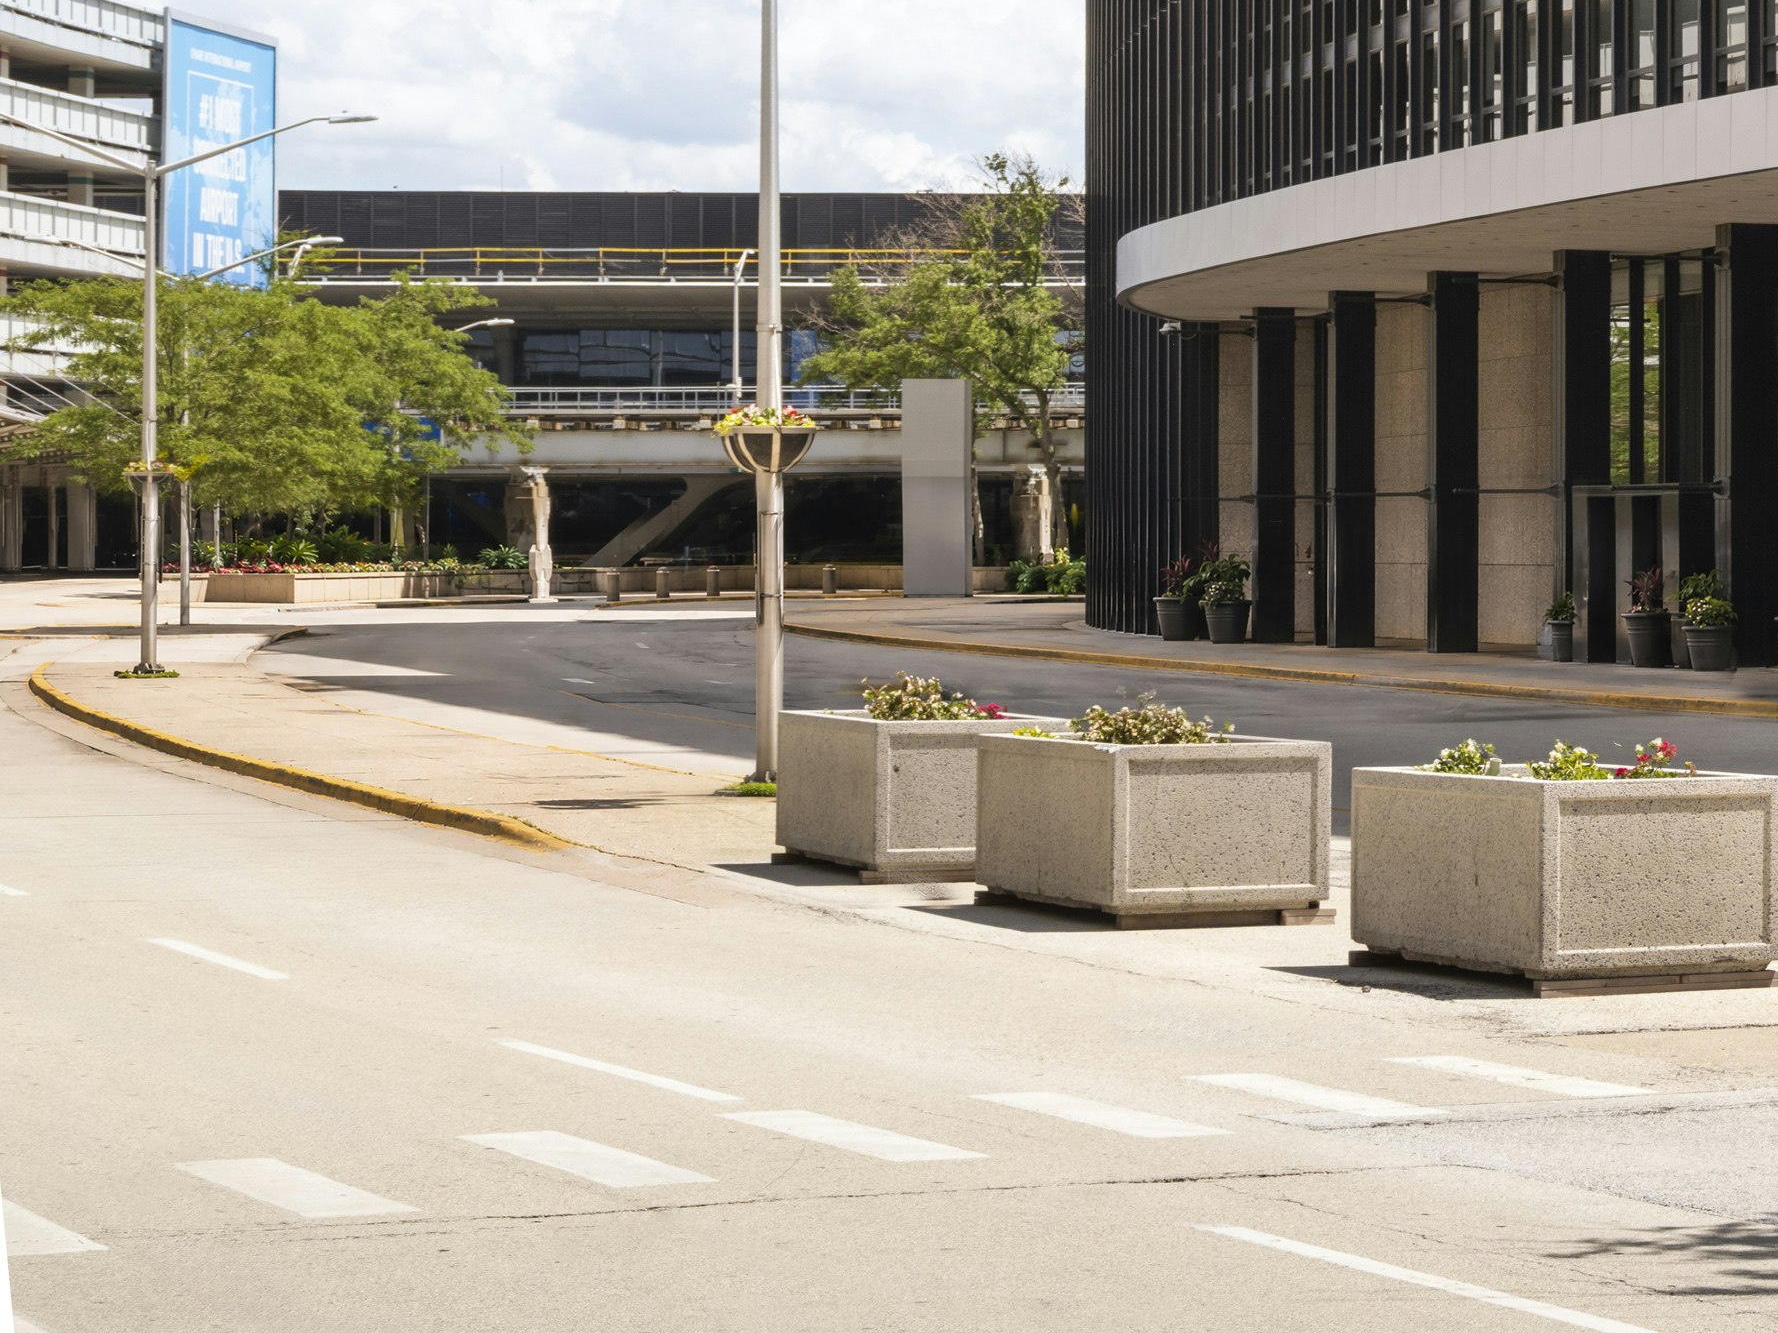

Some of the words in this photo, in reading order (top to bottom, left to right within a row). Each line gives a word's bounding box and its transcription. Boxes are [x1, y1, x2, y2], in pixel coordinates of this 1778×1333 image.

[200, 186, 239, 227] AIRPORT
[193, 232, 204, 267] IN
[206, 233, 225, 271] THE
